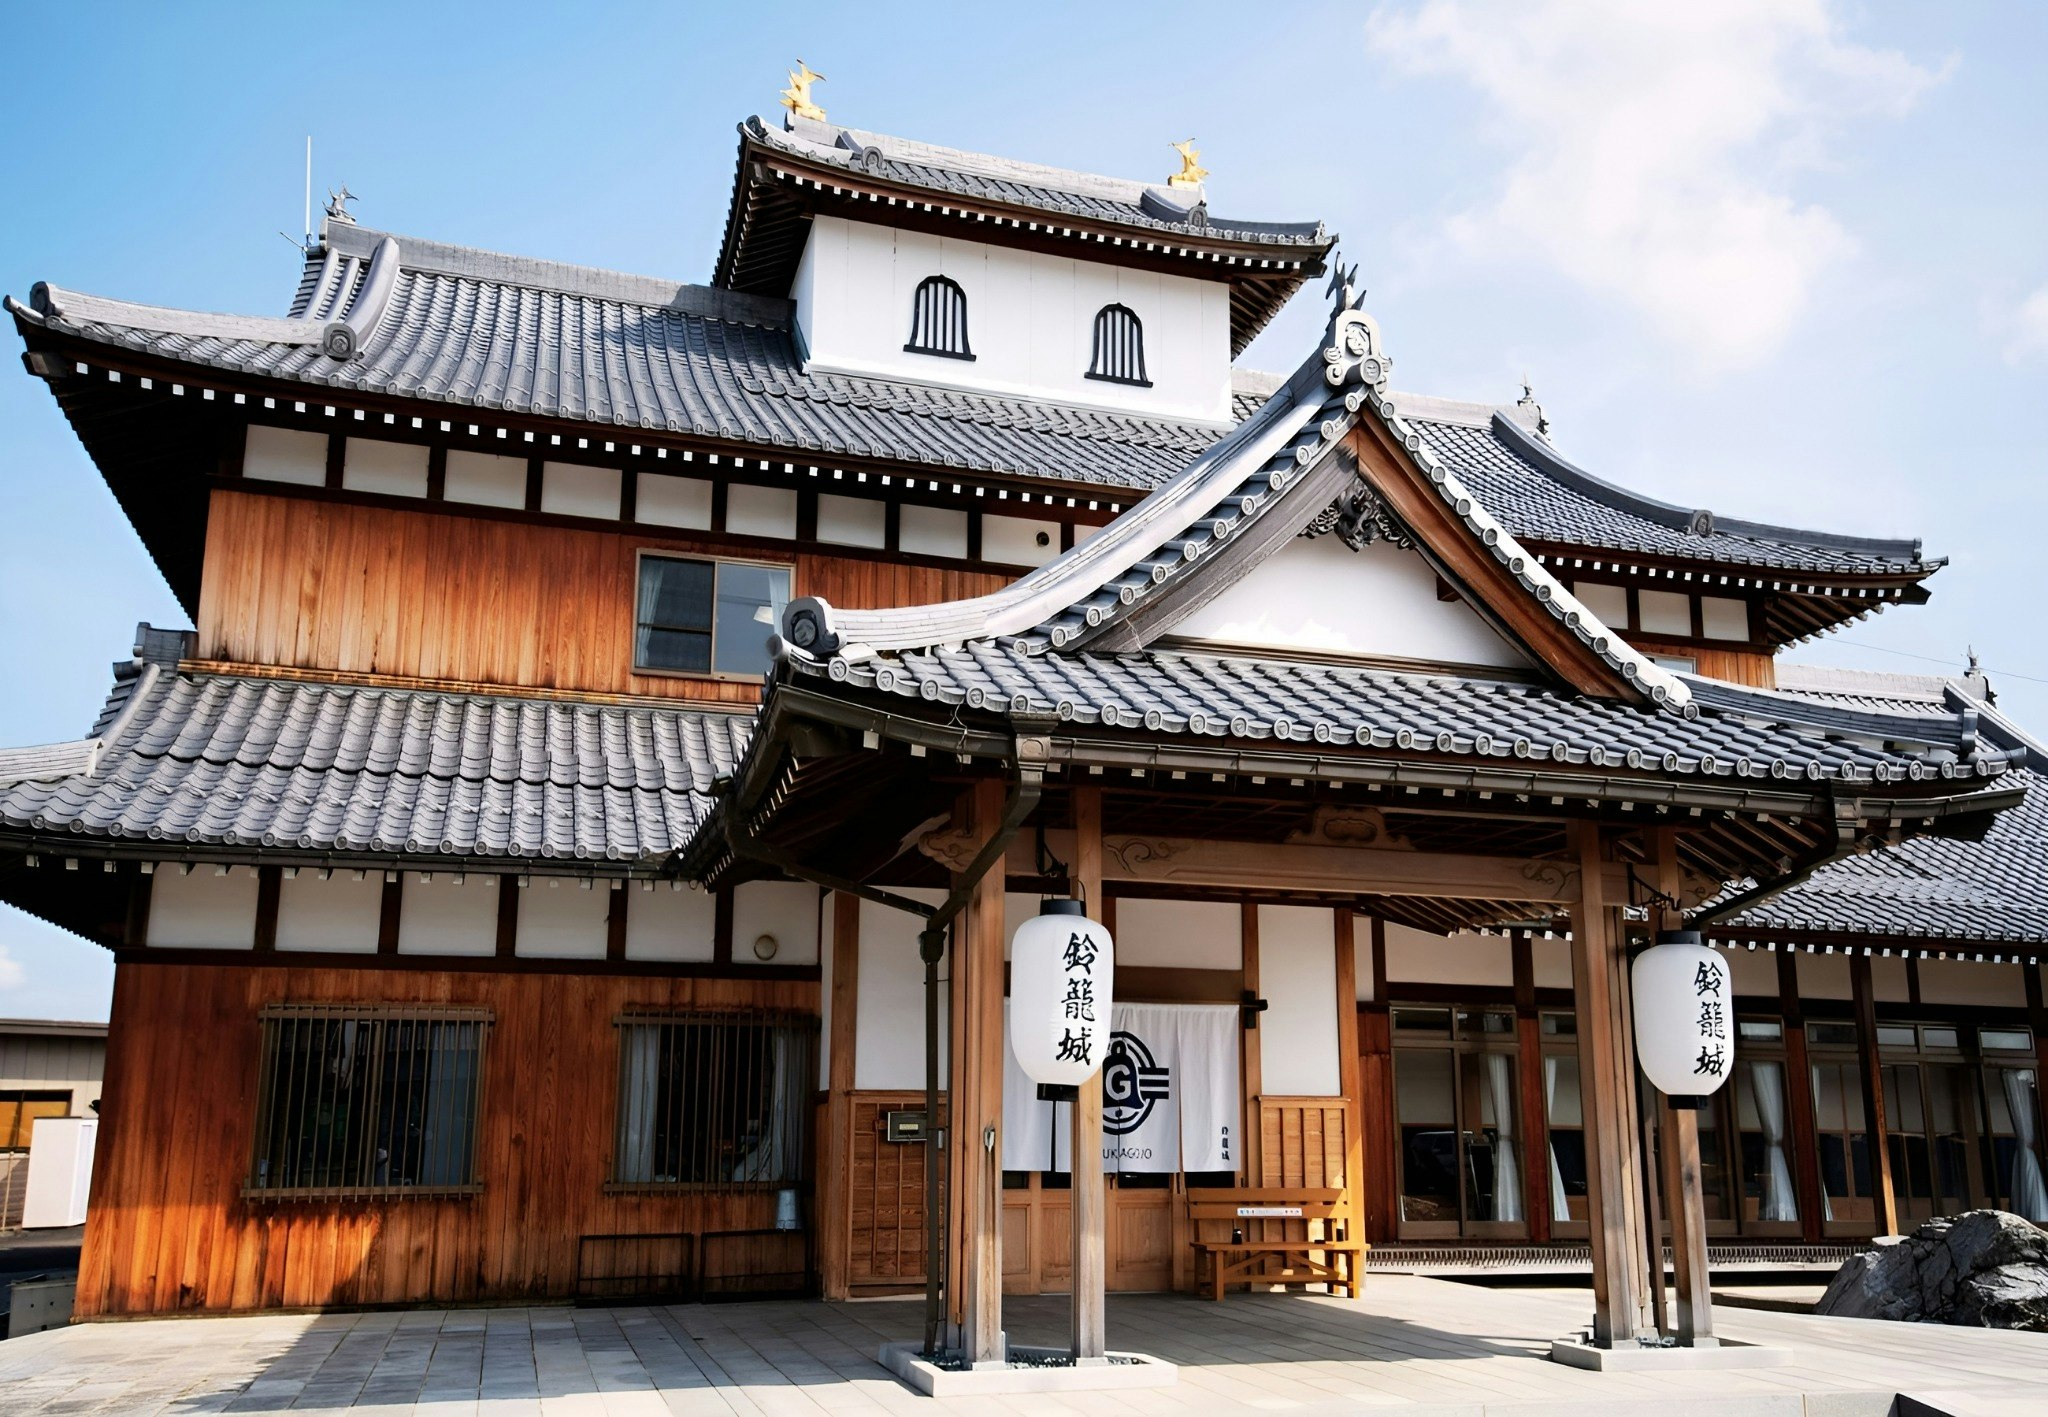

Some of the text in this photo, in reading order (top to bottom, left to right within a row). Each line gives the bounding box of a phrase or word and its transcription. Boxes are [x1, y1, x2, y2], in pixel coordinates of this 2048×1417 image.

[1056, 932, 1099, 1066] 鈴籠城
[1694, 961, 1726, 1077] 鈴籠城
[1105, 1064, 1132, 1101] G
